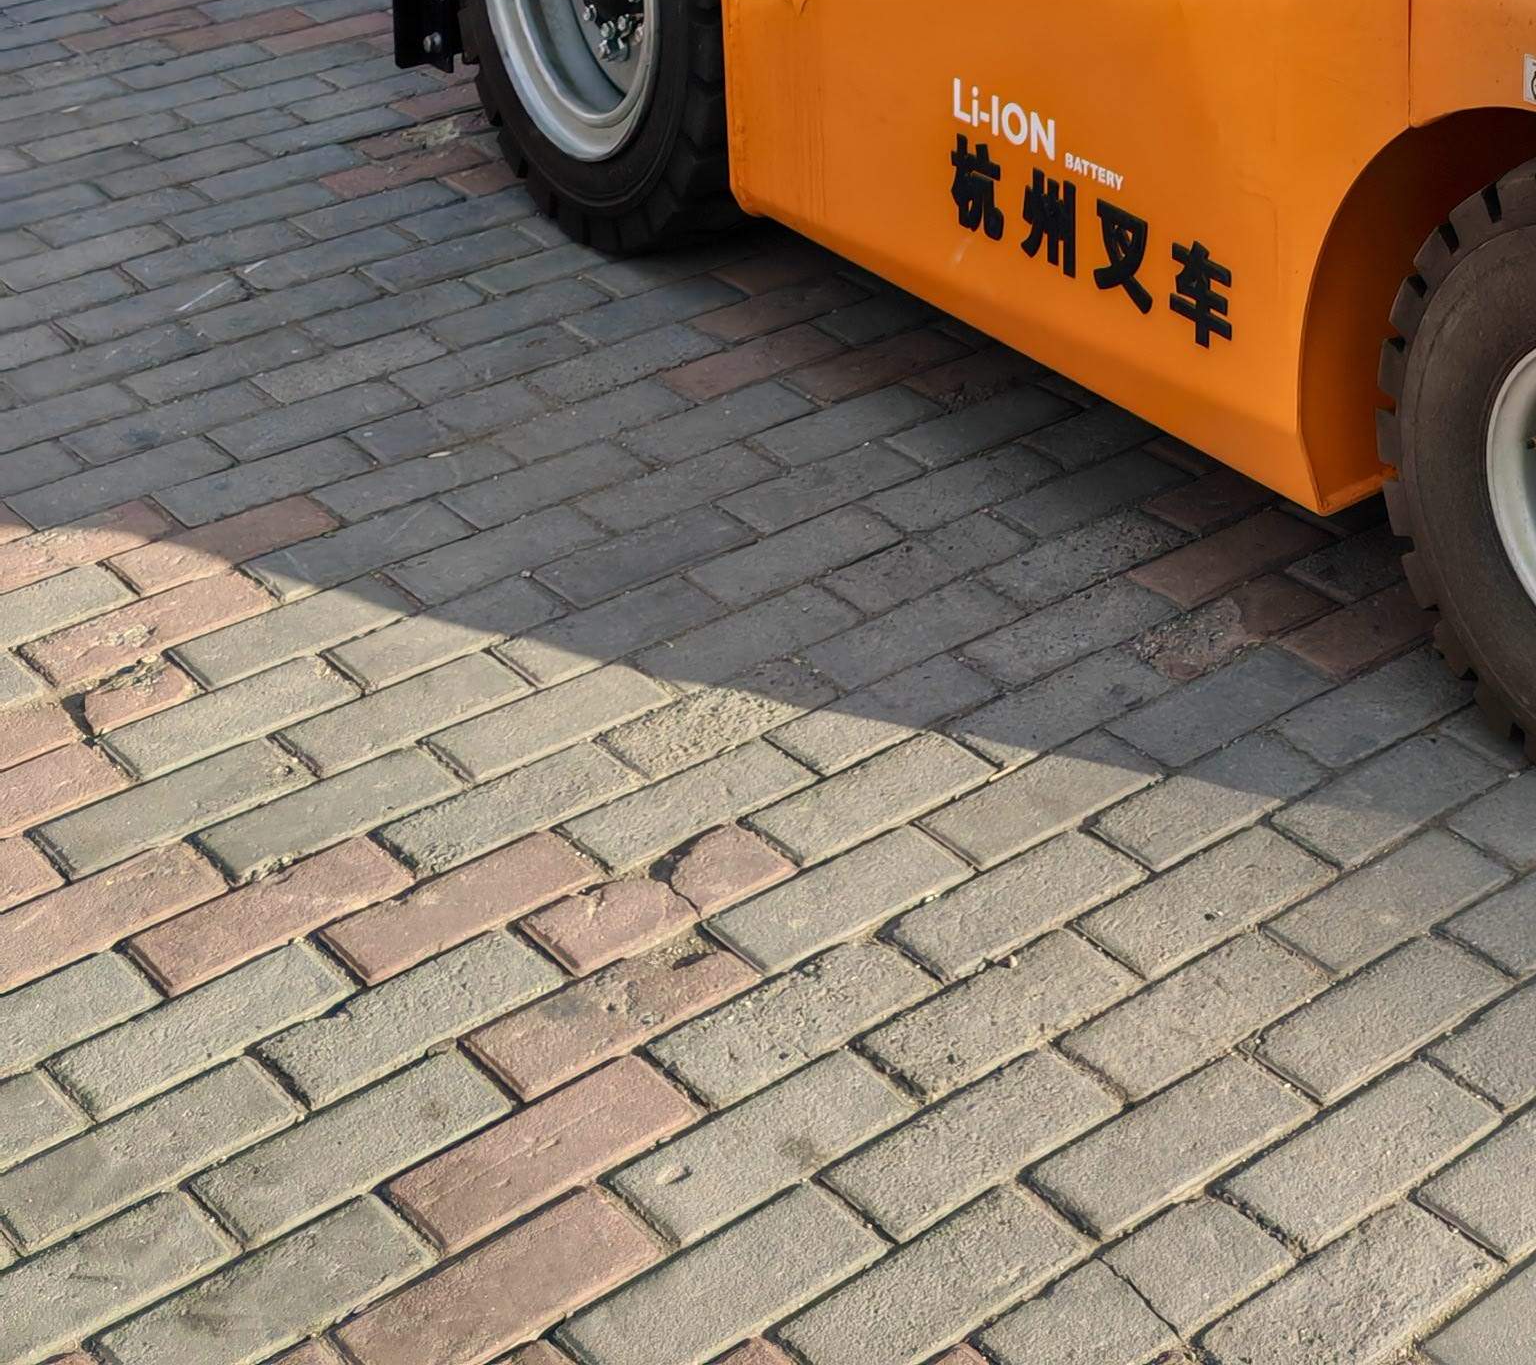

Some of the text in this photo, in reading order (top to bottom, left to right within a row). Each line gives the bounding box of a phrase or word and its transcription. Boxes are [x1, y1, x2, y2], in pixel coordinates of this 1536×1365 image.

[1064, 151, 1124, 191] BATTERY
[950, 133, 1232, 349] 杭州叉车
